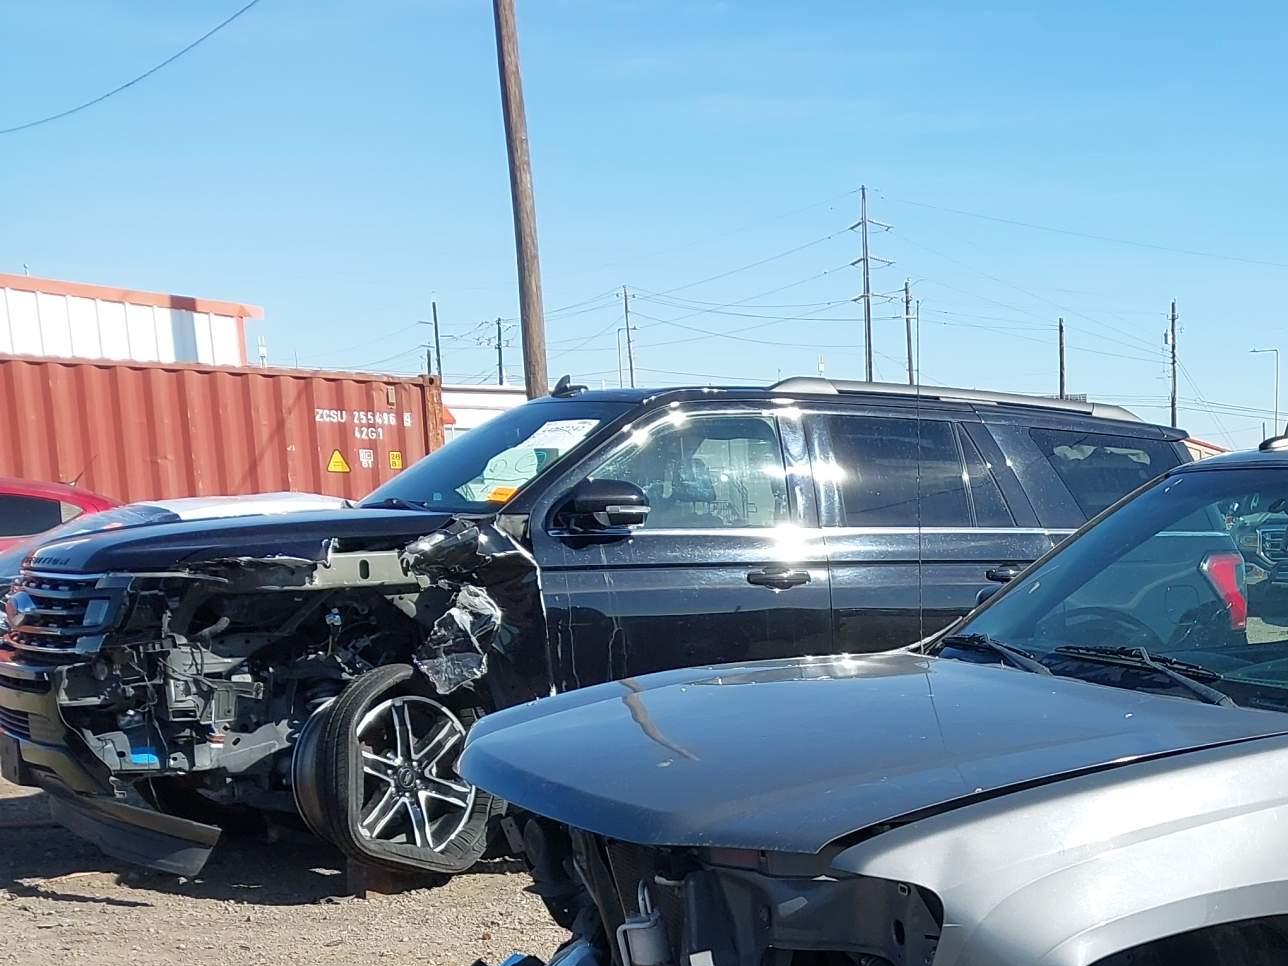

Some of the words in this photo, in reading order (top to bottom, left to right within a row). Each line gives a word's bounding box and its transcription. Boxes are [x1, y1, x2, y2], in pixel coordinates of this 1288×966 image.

[315, 409, 346, 422] ZCSU
[353, 411, 396, 425] 255496
[354, 427, 383, 440] 42G1
